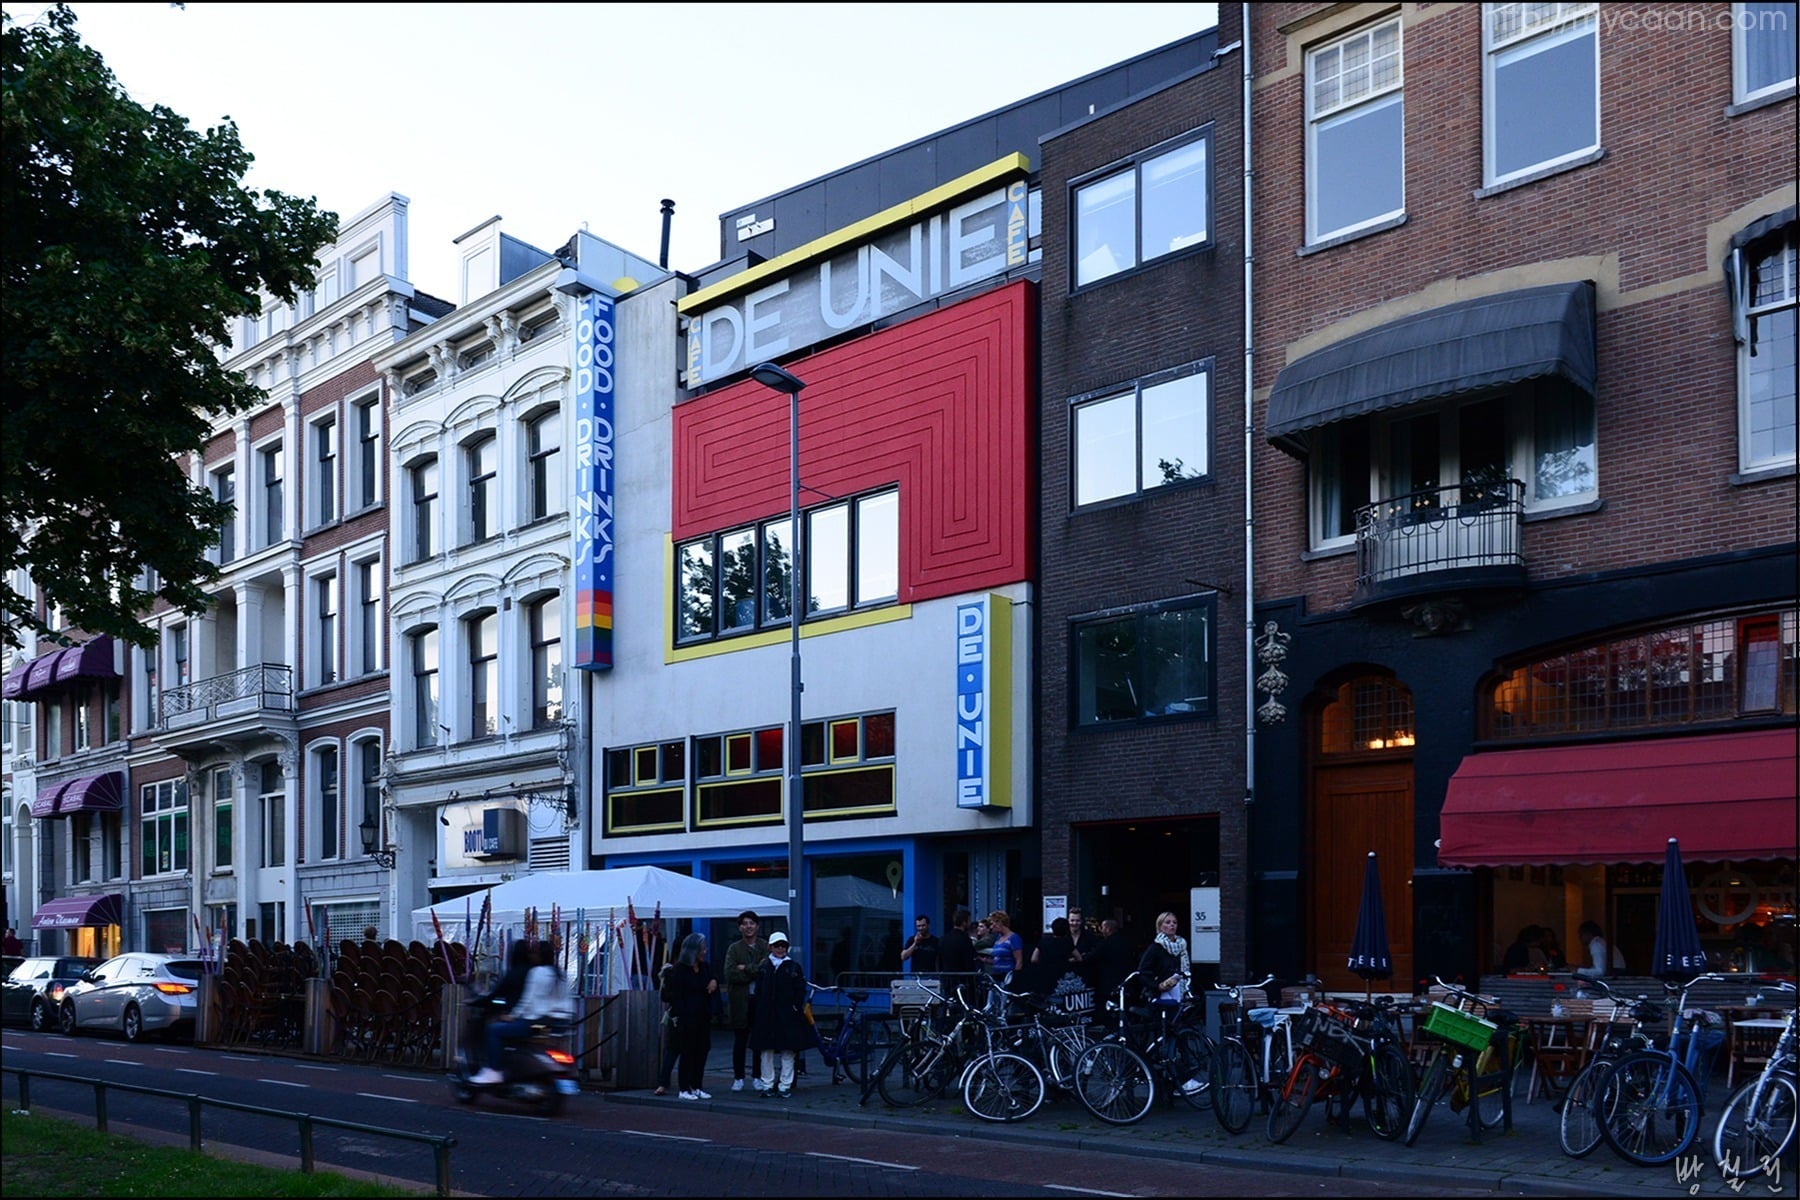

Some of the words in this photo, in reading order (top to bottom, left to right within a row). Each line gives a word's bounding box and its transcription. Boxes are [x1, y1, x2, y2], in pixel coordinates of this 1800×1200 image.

[1007, 180, 1025, 266] CAFE
[702, 278, 790, 382] DE
[820, 186, 1006, 329] UNIE
[577, 294, 593, 396] FOOD
[594, 293, 614, 394] FOOD
[688, 315, 703, 385] CAFE
[577, 417, 593, 565] DRINKS
[594, 416, 614, 564] DRINKS
[958, 606, 983, 664] DE
[958, 692, 983, 805] UNIE
[1194, 911, 1207, 921] 35
[1065, 990, 1096, 1013] UNIE
